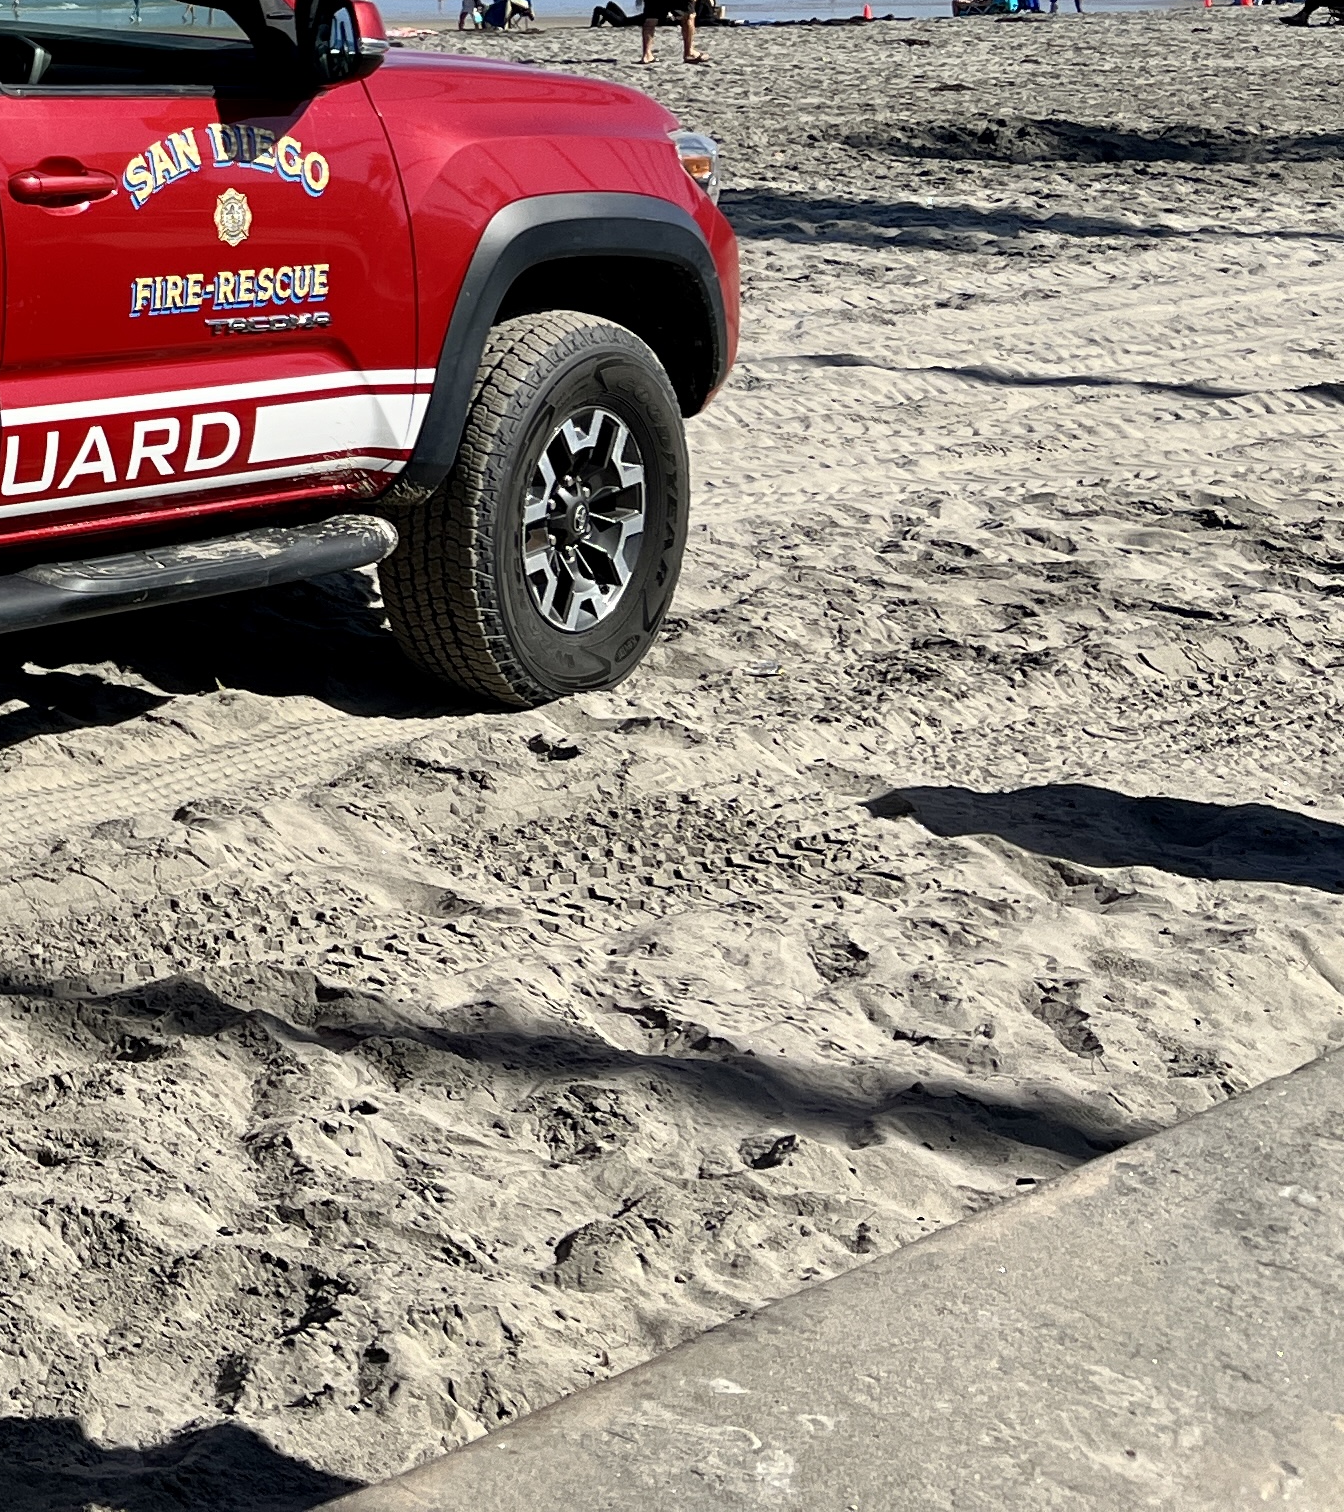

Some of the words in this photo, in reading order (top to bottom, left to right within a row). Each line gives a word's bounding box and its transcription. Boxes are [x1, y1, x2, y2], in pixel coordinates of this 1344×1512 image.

[123, 127, 201, 210] SAN
[205, 123, 330, 197] DIEGO
[129, 263, 330, 317] FIRE-RESCUE
[204, 311, 331, 335] TACOMA
